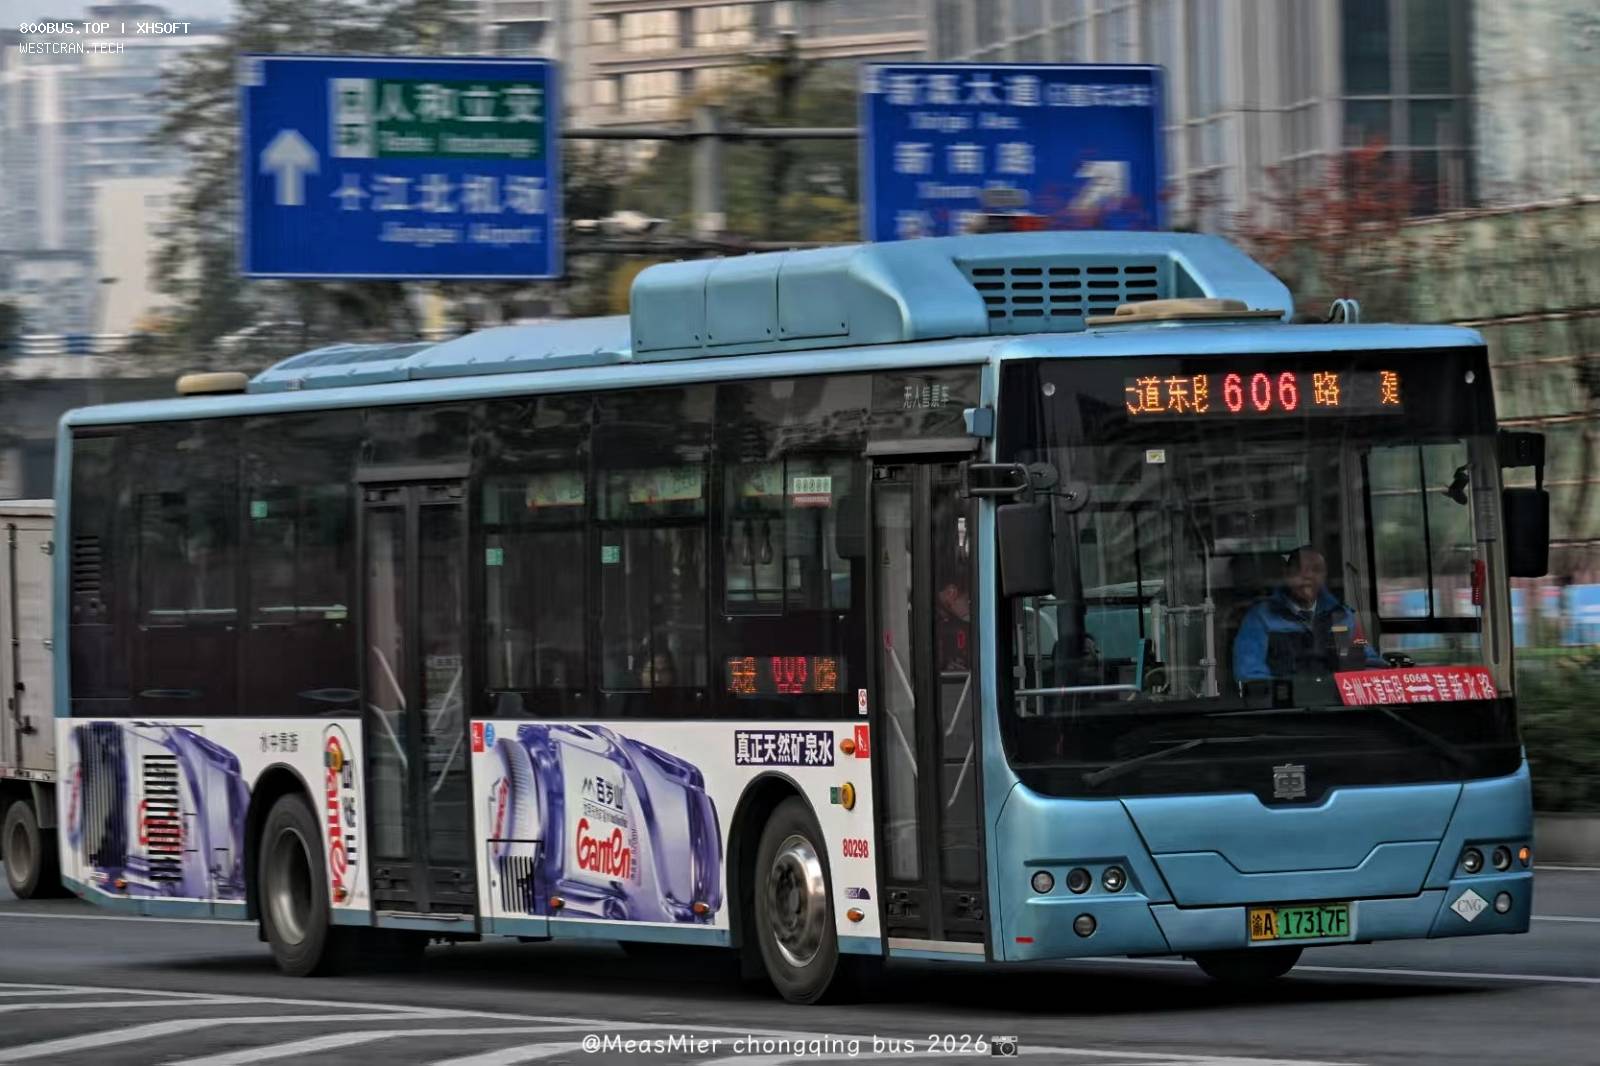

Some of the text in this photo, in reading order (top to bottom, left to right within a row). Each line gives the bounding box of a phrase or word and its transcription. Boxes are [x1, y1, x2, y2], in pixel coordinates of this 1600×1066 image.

[1223, 371, 1298, 412] 606
[736, 732, 834, 765] 真正天然矿泉水
[576, 817, 631, 880] Ganten
[842, 838, 869, 858] 80298
[1457, 898, 1482, 912] CNG
[1284, 909, 1346, 935] 17317F
